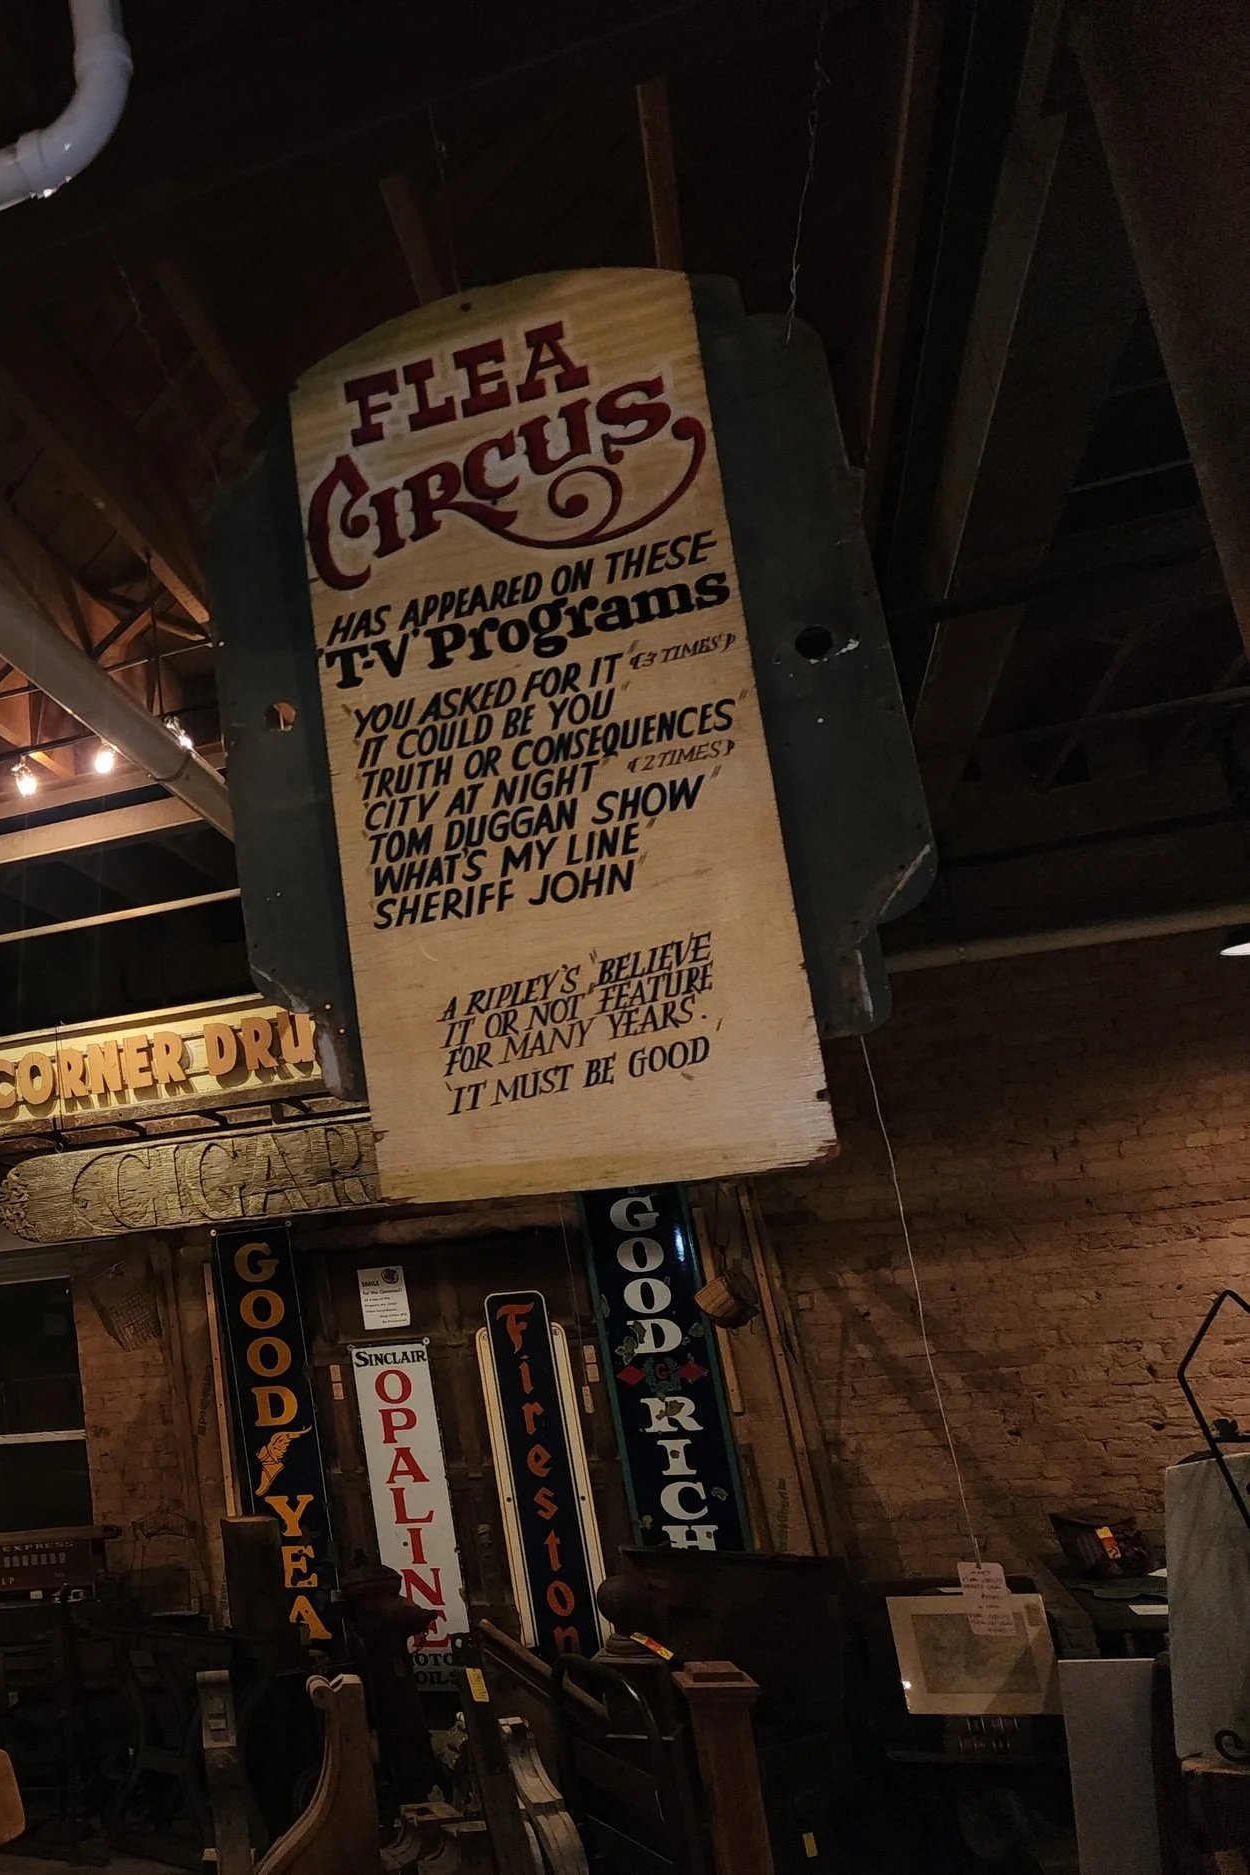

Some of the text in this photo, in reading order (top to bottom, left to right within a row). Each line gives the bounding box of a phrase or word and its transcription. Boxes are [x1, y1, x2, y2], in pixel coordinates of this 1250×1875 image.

[342, 320, 590, 448] FLEA
[307, 376, 706, 590] CIRCUS
[327, 529, 719, 647] HAS APPEARED ON THESE
[425, 571, 731, 671] Programs
[416, 676, 517, 725] ASKED
[523, 662, 582, 711] FOR
[396, 712, 494, 760] COULD
[501, 703, 536, 740] BE
[463, 745, 503, 780] OR
[443, 782, 486, 818] AT
[443, 798, 578, 852] DUGGAN
[500, 836, 559, 878] MY
[436, 996, 458, 1023] A
[464, 964, 582, 1017] RIPLEY'S
[439, 1017, 476, 1049] IT
[484, 1009, 520, 1039] OR
[595, 960, 715, 1015] FEATURE
[442, 1041, 494, 1078] FOR
[497, 1017, 596, 1065] MANY
[490, 1063, 575, 1107] MUST
[582, 1052, 618, 1088] BE
[354, 1350, 427, 1368] SINCLAIR
[2, 1541, 74, 1553] EXPRESS
